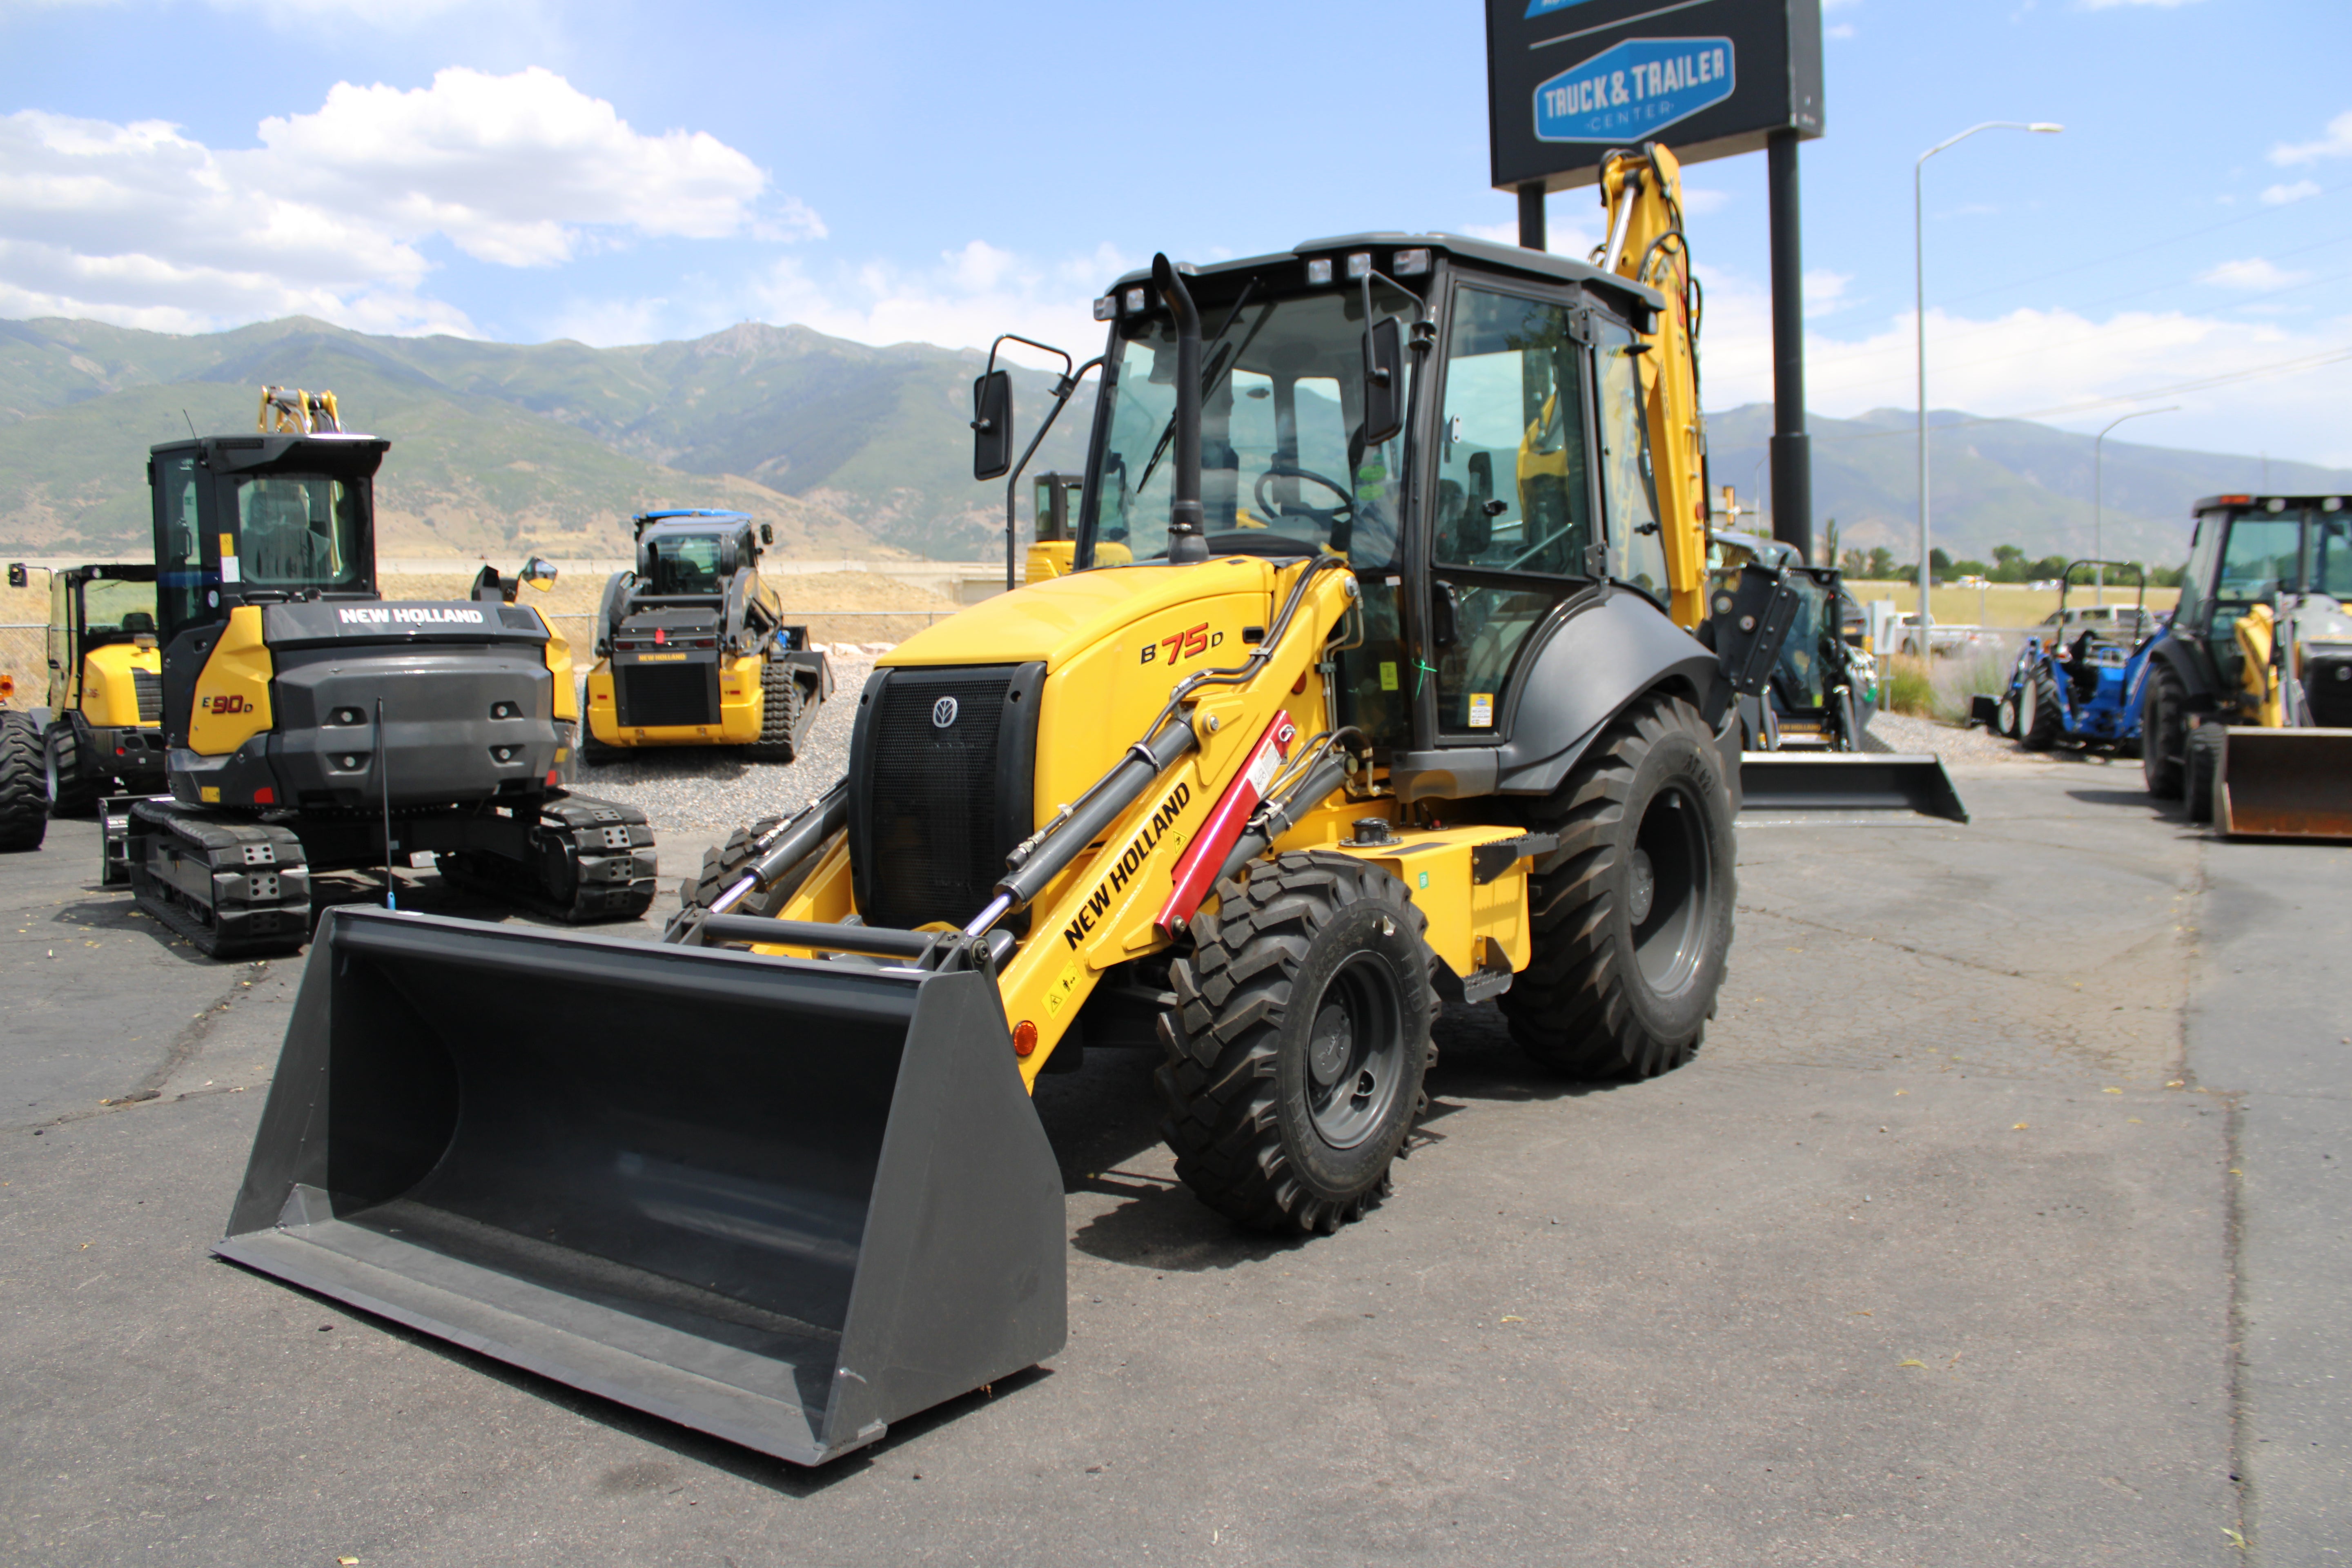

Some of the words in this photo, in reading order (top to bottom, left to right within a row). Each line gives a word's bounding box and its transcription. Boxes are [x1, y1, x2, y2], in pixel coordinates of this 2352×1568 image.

[1545, 75, 1609, 118] TRUCK
[1611, 71, 1630, 106] &
[1631, 48, 1724, 100] TRAILER
[1591, 101, 1670, 131] CENTER
[339, 608, 390, 623] NEW
[393, 608, 483, 624] HOLLAND
[1064, 883, 1111, 952] NEW
[1109, 782, 1190, 894] HOLLAND
